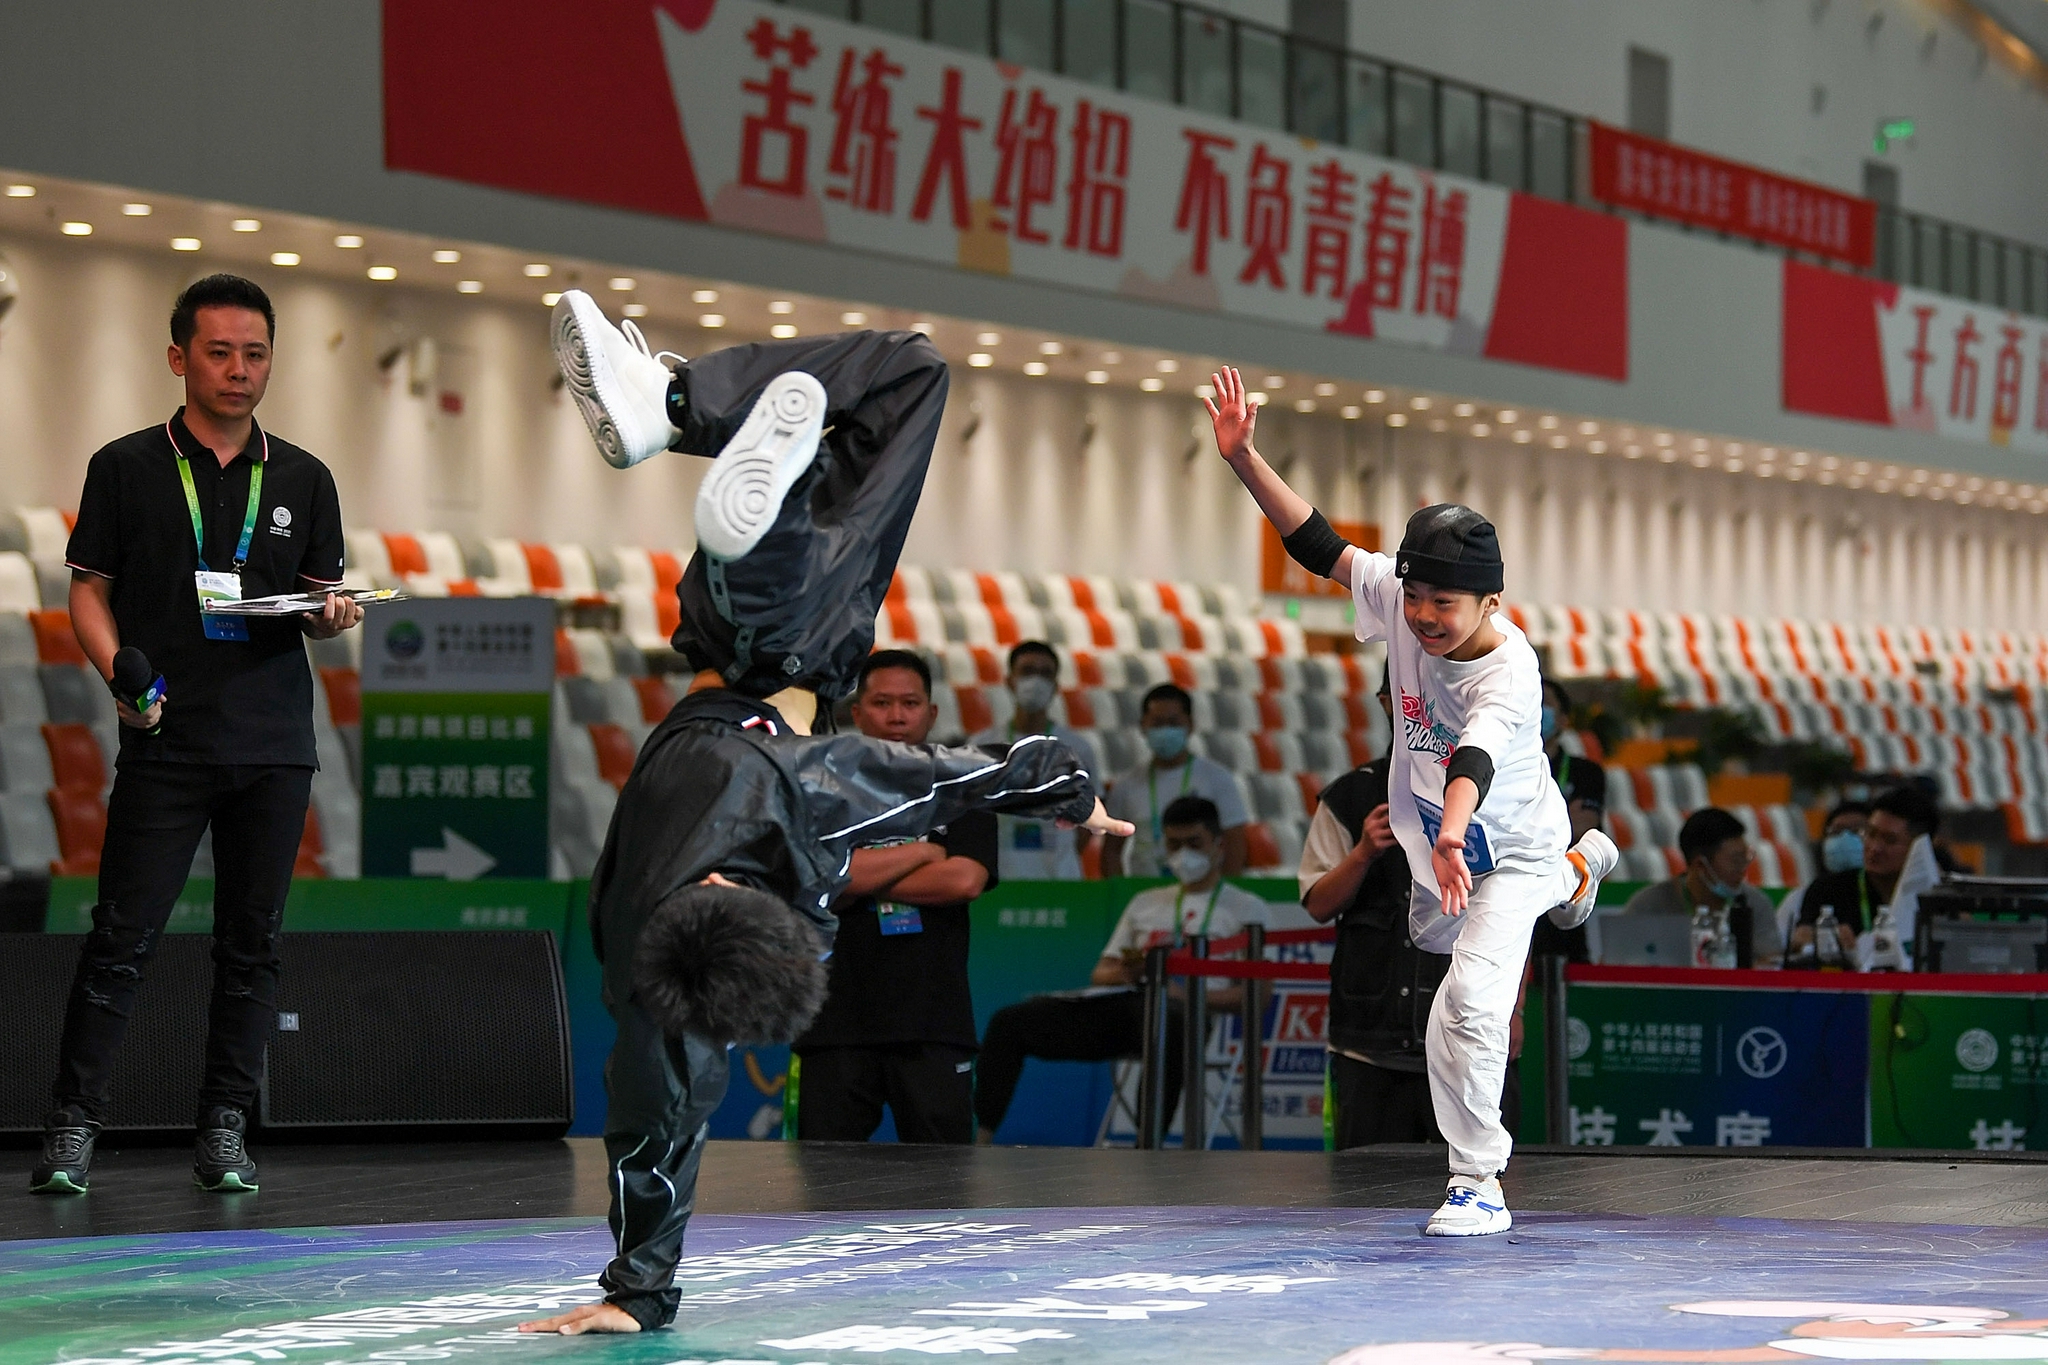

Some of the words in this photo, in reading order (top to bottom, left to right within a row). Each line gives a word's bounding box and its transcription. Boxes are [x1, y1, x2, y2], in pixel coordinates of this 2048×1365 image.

[739, 18, 1132, 258] 苦练大绝招
[1905, 304, 2048, 430] 千方百
[373, 764, 535, 799] 嘉宾观赛区
[751, 1254, 988, 1287] REPUBLIC
[1000, 1225, 1148, 1245] CHINA
[659, 1272, 1339, 1365] 舞比赛
